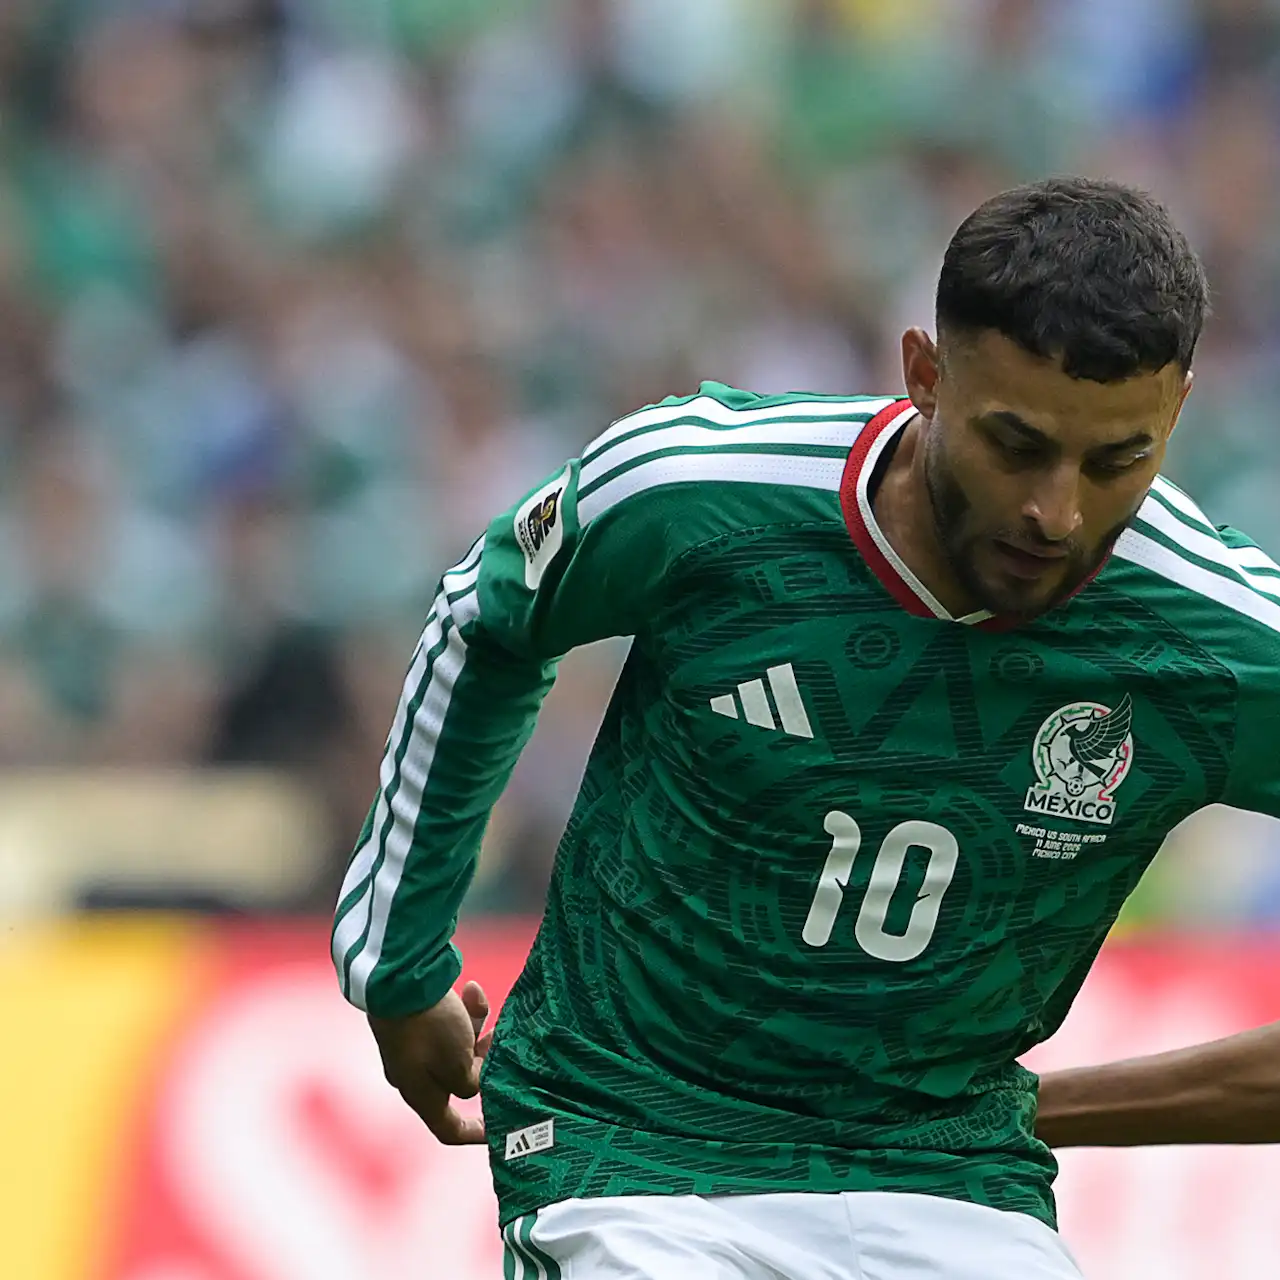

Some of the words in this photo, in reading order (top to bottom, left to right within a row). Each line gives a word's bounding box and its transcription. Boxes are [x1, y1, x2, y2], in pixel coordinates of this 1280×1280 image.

[1027, 791, 1112, 820] MÉXICO
[1036, 838, 1044, 848] 11
[1043, 840, 1062, 850] JUNE
[1058, 832, 1081, 842] SOUTH
[1081, 834, 1107, 844] AFRICA
[1061, 851, 1078, 860] CITY
[802, 810, 959, 962] 10
